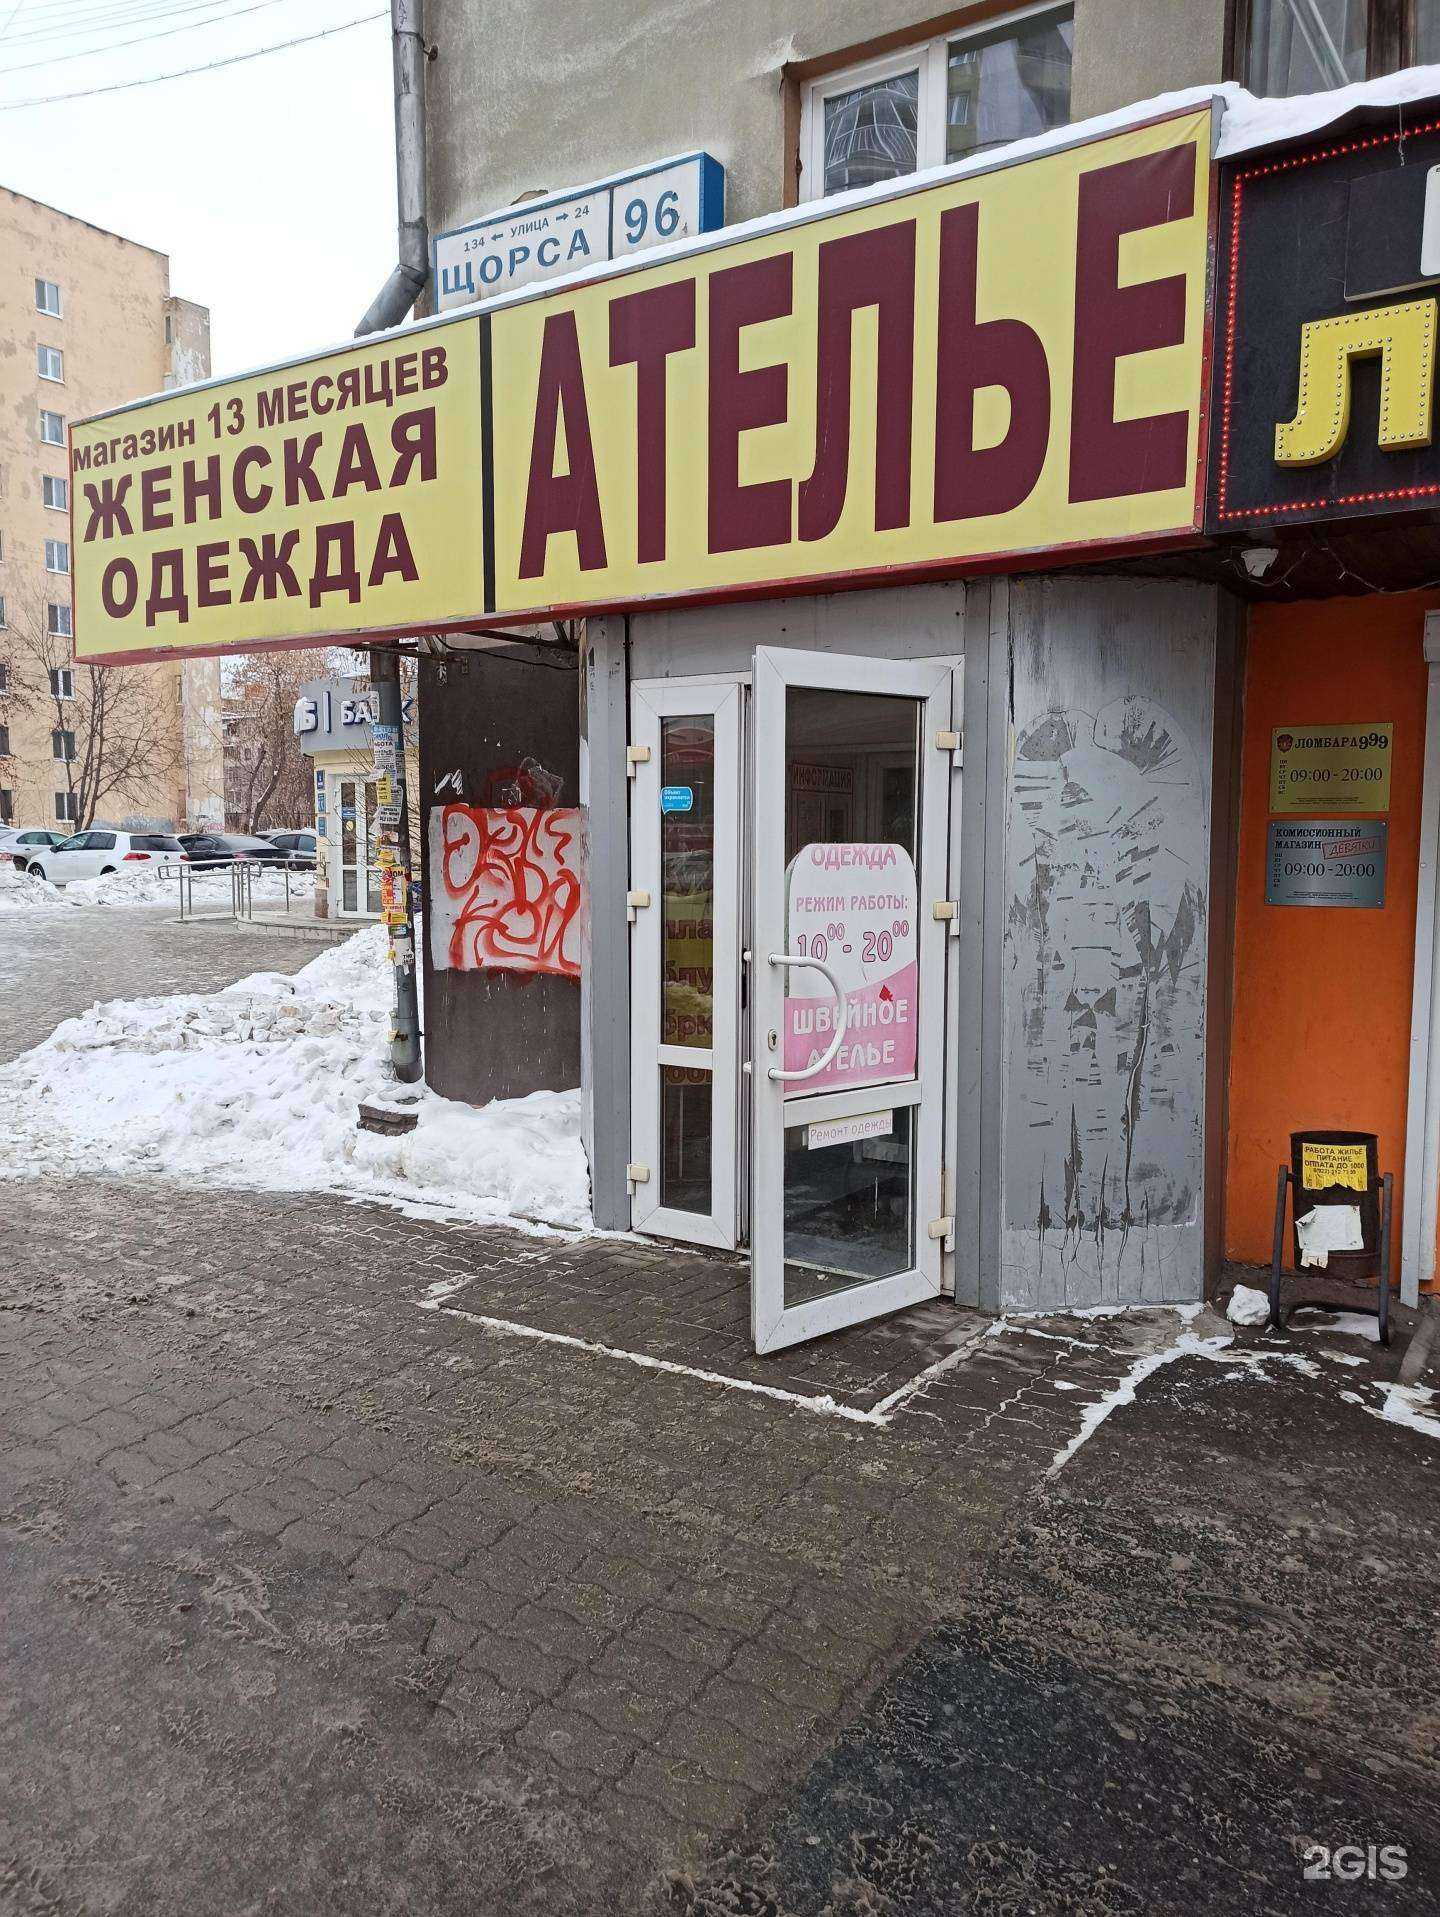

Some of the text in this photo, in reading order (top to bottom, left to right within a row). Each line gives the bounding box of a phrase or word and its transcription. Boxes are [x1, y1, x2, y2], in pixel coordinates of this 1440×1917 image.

[464, 205, 590, 252] 134 УЛИЦА 24
[625, 191, 680, 244] 96
[442, 228, 591, 295] ЩОРСА
[517, 140, 1198, 581] АТЕЛЬЕ
[73, 346, 449, 472] магазин 13 МЕСЯЦЕВ
[83, 406, 438, 543] ЖЕНСКАЯ
[102, 512, 420, 627] ОДЕЖДА
[341, 695, 414, 725] БАК
[1290, 769, 1331, 782] 09:00
[1342, 768, 1383, 781] 20:00
[1275, 840, 1321, 849] МАГАЗИН
[1276, 827, 1361, 837] КОМИССИОННЫЙ
[811, 845, 897, 871] ОДЕЖДА
[1284, 863, 1325, 876] 09:00
[1335, 863, 1375, 877] 20:00
[796, 895, 909, 912] РЕЖИМ РАБОТЫ:
[810, 1118, 892, 1142] Ремонт одежды
[1304, 1146, 1335, 1154] РАБОТА
